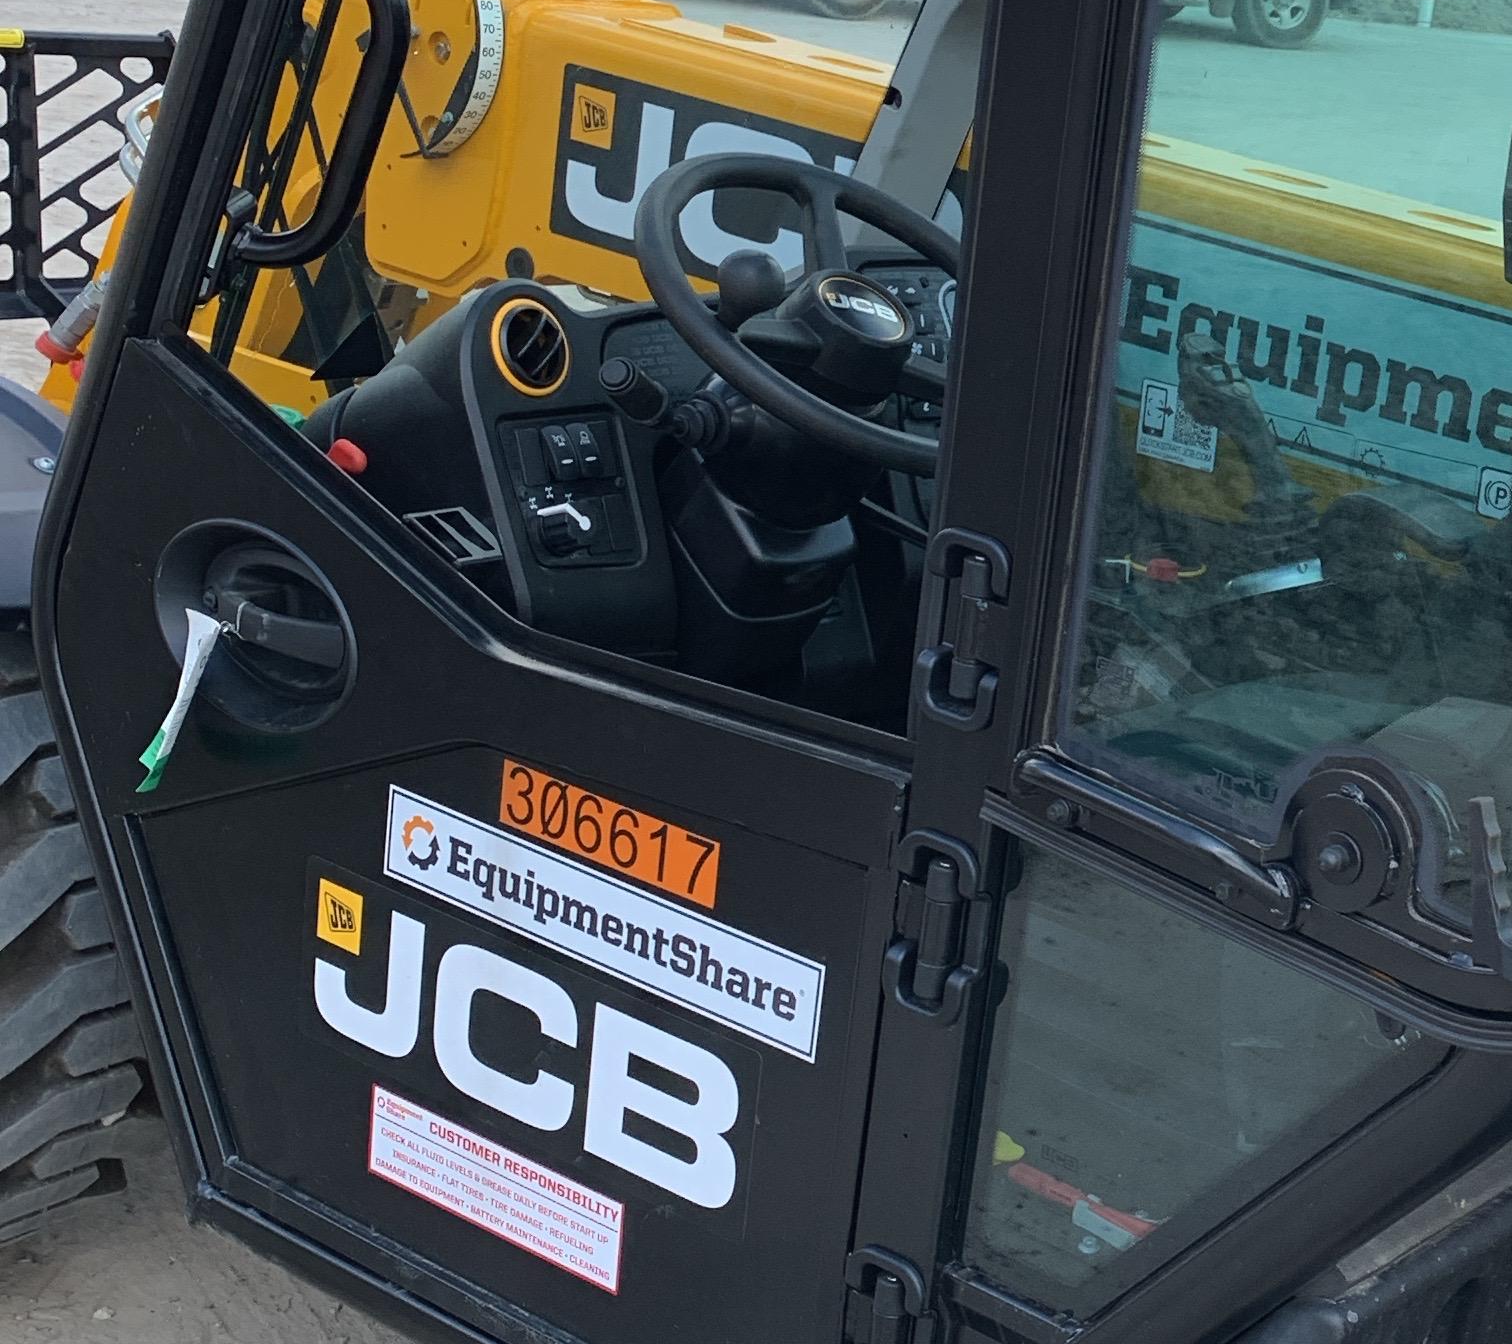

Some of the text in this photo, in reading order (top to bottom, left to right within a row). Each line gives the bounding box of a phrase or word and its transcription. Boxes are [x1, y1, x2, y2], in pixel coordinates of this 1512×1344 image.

[480, 0, 494, 10] 80
[483, 24, 495, 34] 70
[479, 70, 492, 80] 50
[482, 47, 495, 57] 60
[472, 91, 486, 101] 40
[584, 101, 606, 129] JCB
[566, 102, 860, 283] JC
[825, 292, 899, 323] JCB
[506, 766, 715, 895] 306617
[330, 899, 354, 930] JCB
[446, 835, 798, 1022] EquipmentShare
[314, 910, 740, 1209] JCB
[380, 1126, 405, 1147] CHECK
[406, 1139, 419, 1154] ALL
[421, 1146, 444, 1166] FLUID
[445, 1158, 472, 1180] LEVELS
[481, 1175, 512, 1199] GREASE
[513, 1191, 536, 1211] DAILY
[537, 1203, 567, 1226] BEFORE
[570, 1219, 595, 1239] START
[597, 1232, 608, 1246] UP
[392, 1149, 593, 1255] INSURANCE FLAT TIRES TIRE DAMAGE REFUELING
[429, 1120, 618, 1224] CUSTOMER RESPONSIBILITY
[375, 1157, 610, 1281] DAMAGE TO EQUIPMENT BATTERY MAINTENANCE CLEANING
